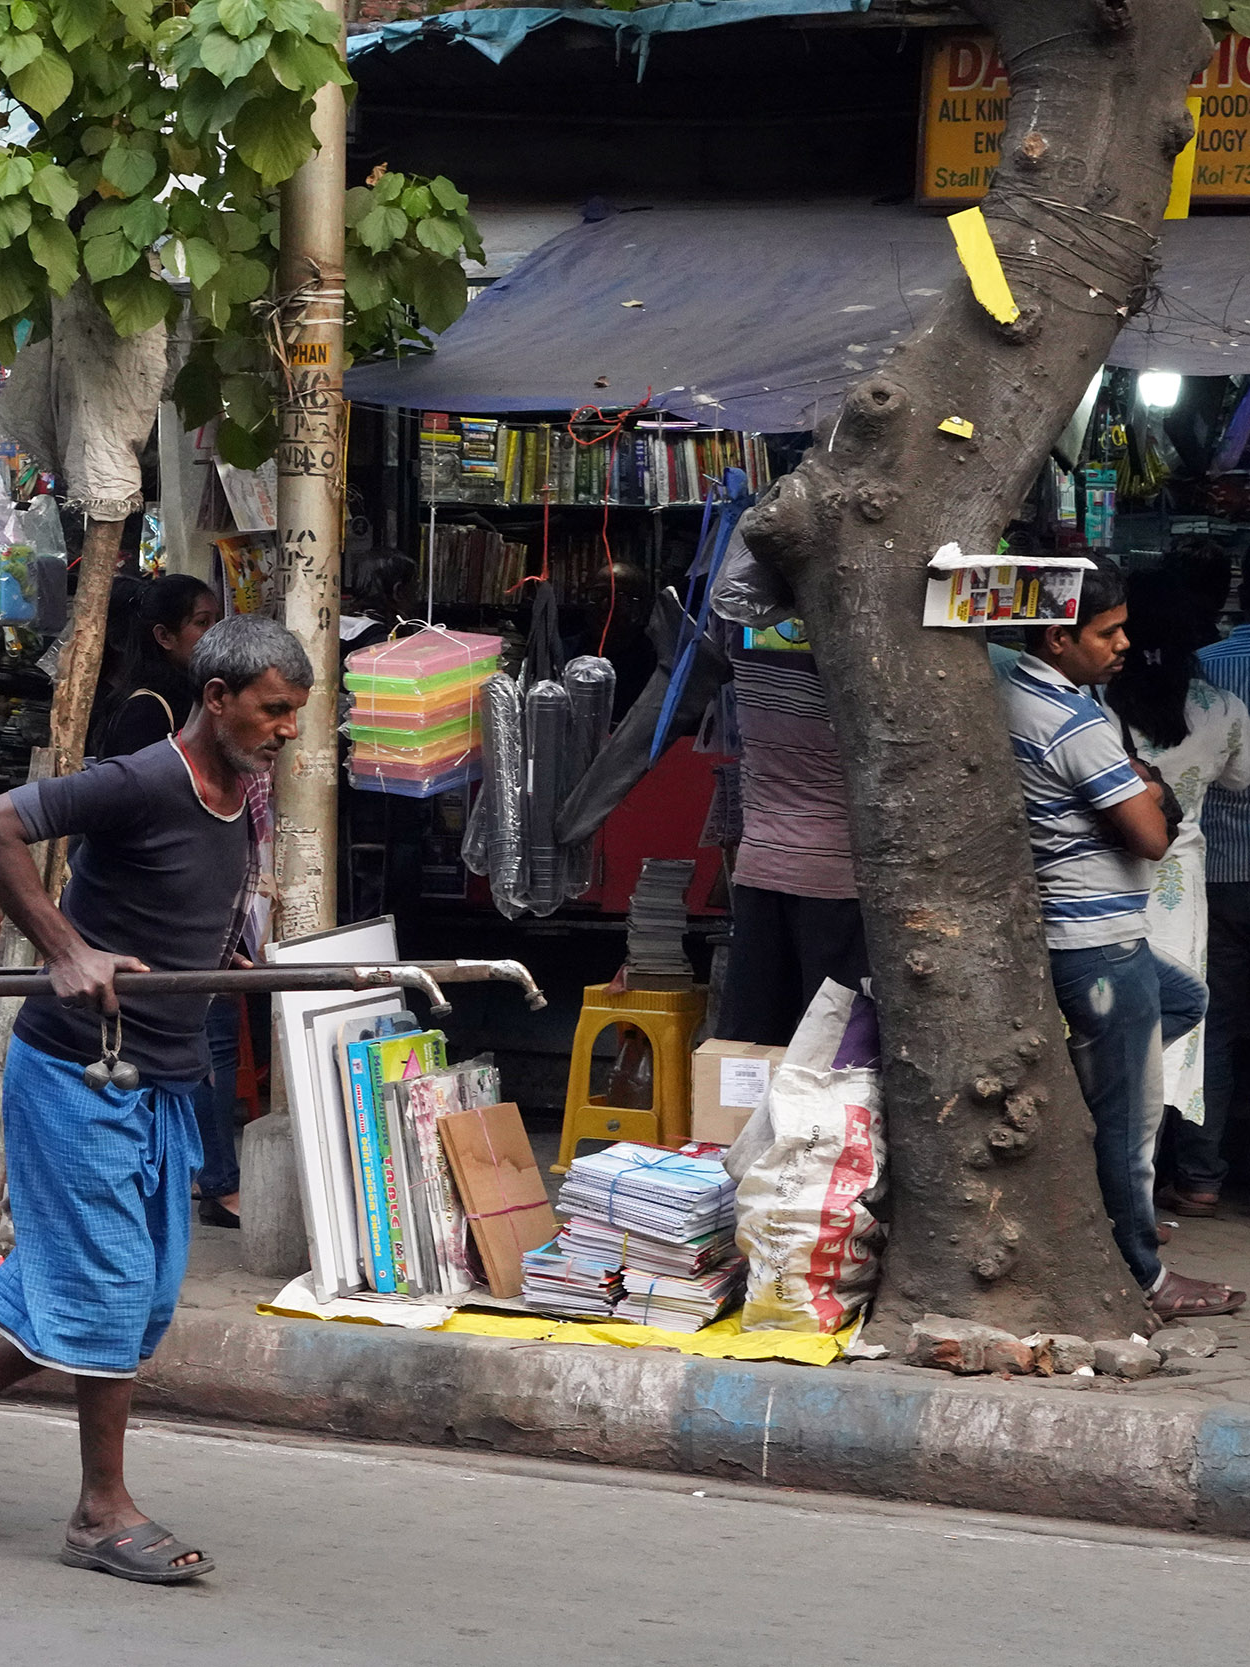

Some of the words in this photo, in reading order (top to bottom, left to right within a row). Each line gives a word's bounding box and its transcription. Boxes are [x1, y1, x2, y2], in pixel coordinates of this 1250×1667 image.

[939, 99, 972, 122] ALL
[1196, 129, 1247, 152] LOGY
[935, 167, 980, 188] Stall
[355, 1084, 363, 1110] STAND
[361, 1137, 370, 1163] LUDO
[373, 1055, 383, 1088] Multi
[384, 1155, 400, 1229] TABLE
[363, 1166, 376, 1212] WOODEN
[370, 1213, 382, 1257] FOLDING
